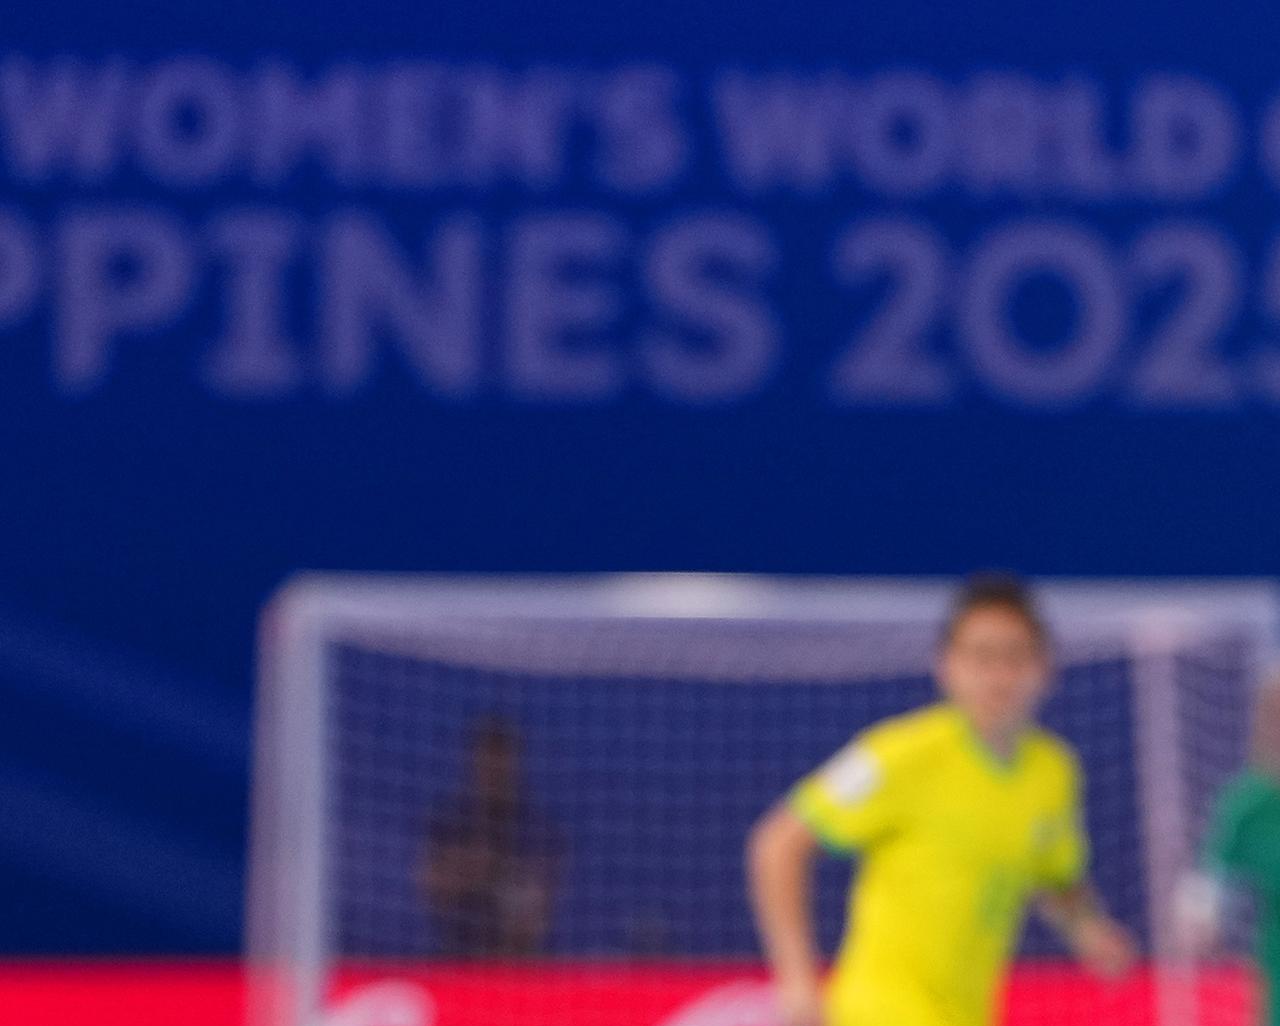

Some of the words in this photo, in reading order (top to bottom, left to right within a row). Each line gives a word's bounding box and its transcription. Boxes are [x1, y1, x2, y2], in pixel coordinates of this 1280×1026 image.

[4, 60, 690, 186] WOMEN'S
[714, 68, 1244, 194] WORLD
[0, 212, 785, 394] PINES
